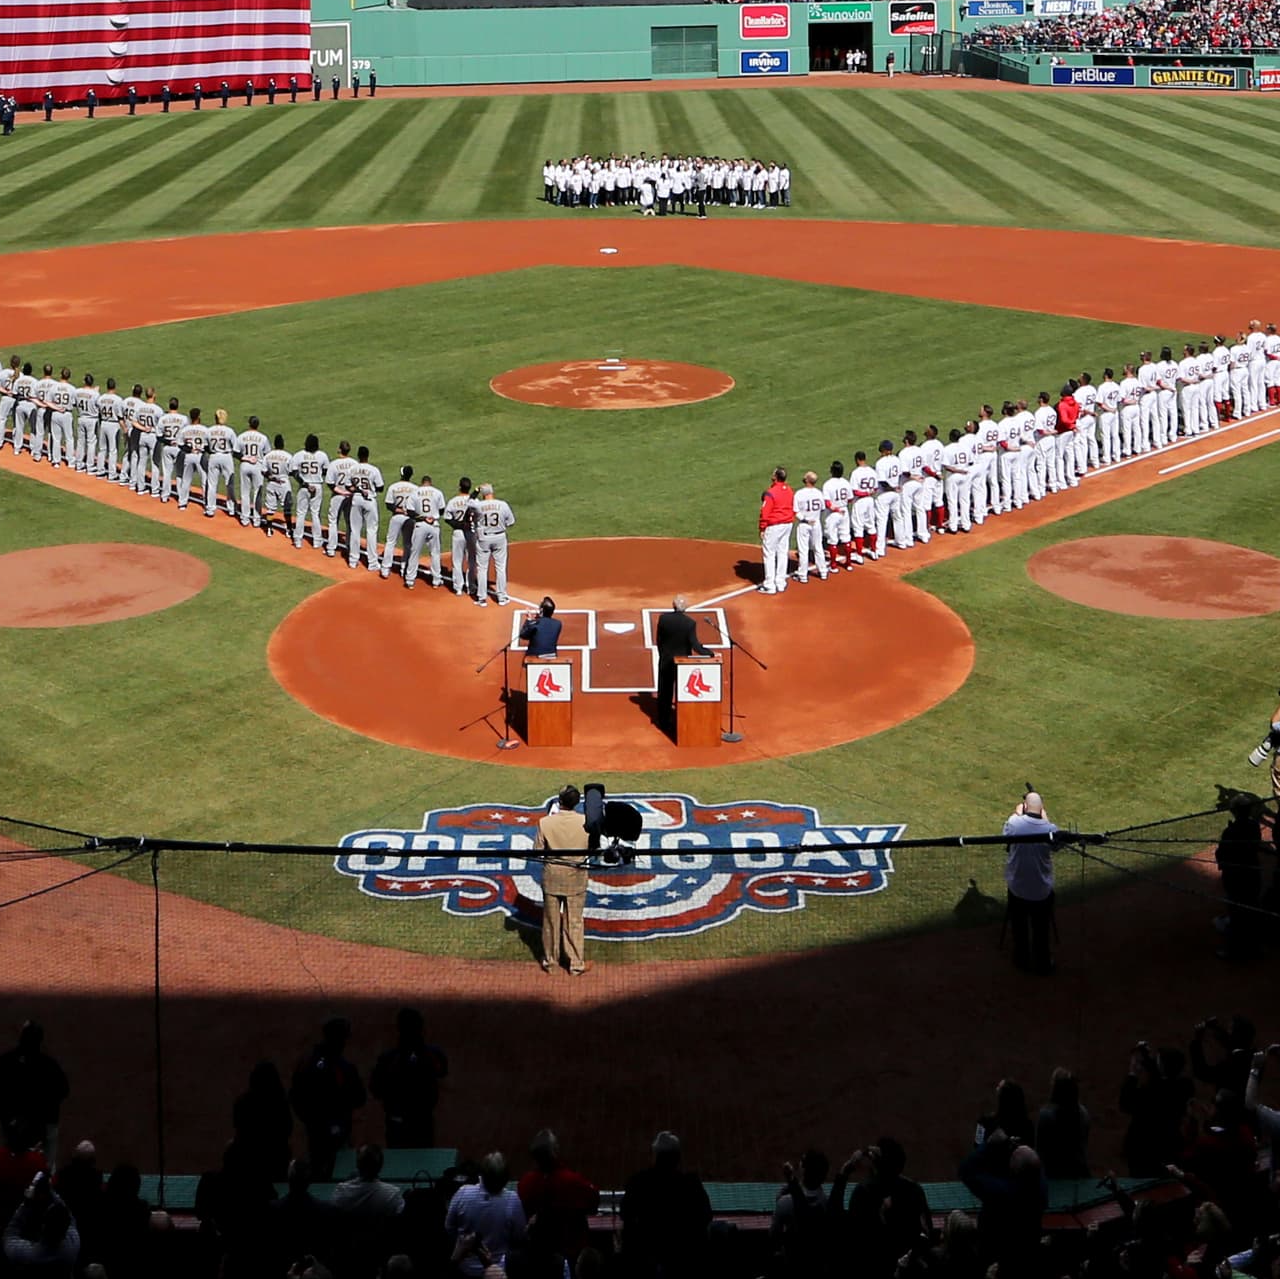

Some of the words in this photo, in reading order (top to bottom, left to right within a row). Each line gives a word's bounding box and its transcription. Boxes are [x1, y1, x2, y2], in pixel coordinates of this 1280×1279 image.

[1044, 0, 1071, 12] NESN
[1076, 0, 1097, 11] FUEL
[821, 8, 872, 21] sunovion
[890, 11, 934, 21] Safelite
[310, 49, 343, 66] TUM
[749, 58, 780, 67] IRVING
[351, 60, 371, 70] 379
[1071, 68, 1116, 84] jetBlue
[1152, 71, 1204, 84] GRANITE
[1206, 70, 1234, 85] CITY
[54, 393, 70, 406] 39
[210, 437, 227, 450] 73
[244, 443, 259, 457] 10
[271, 462, 280, 475] 5
[300, 461, 319, 475] 55
[421, 498, 431, 513] 6
[483, 512, 500, 527] 13
[731, 825, 905, 871] DAY
